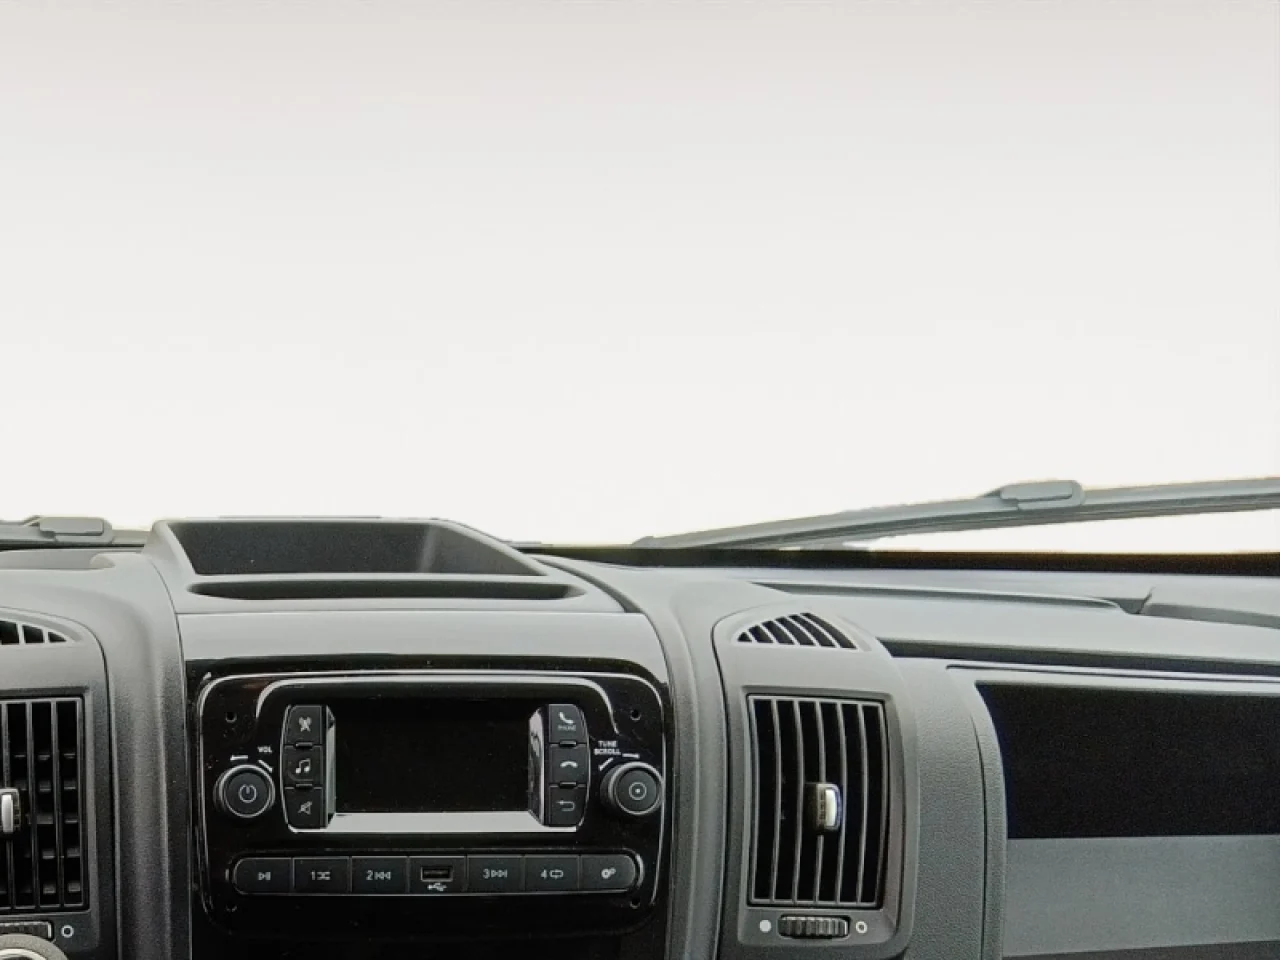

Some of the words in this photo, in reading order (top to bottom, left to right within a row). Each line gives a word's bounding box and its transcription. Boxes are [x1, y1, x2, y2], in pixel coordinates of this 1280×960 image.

[366, 869, 374, 880] 2
[482, 868, 490, 879] 3
[540, 869, 548, 880] 4
